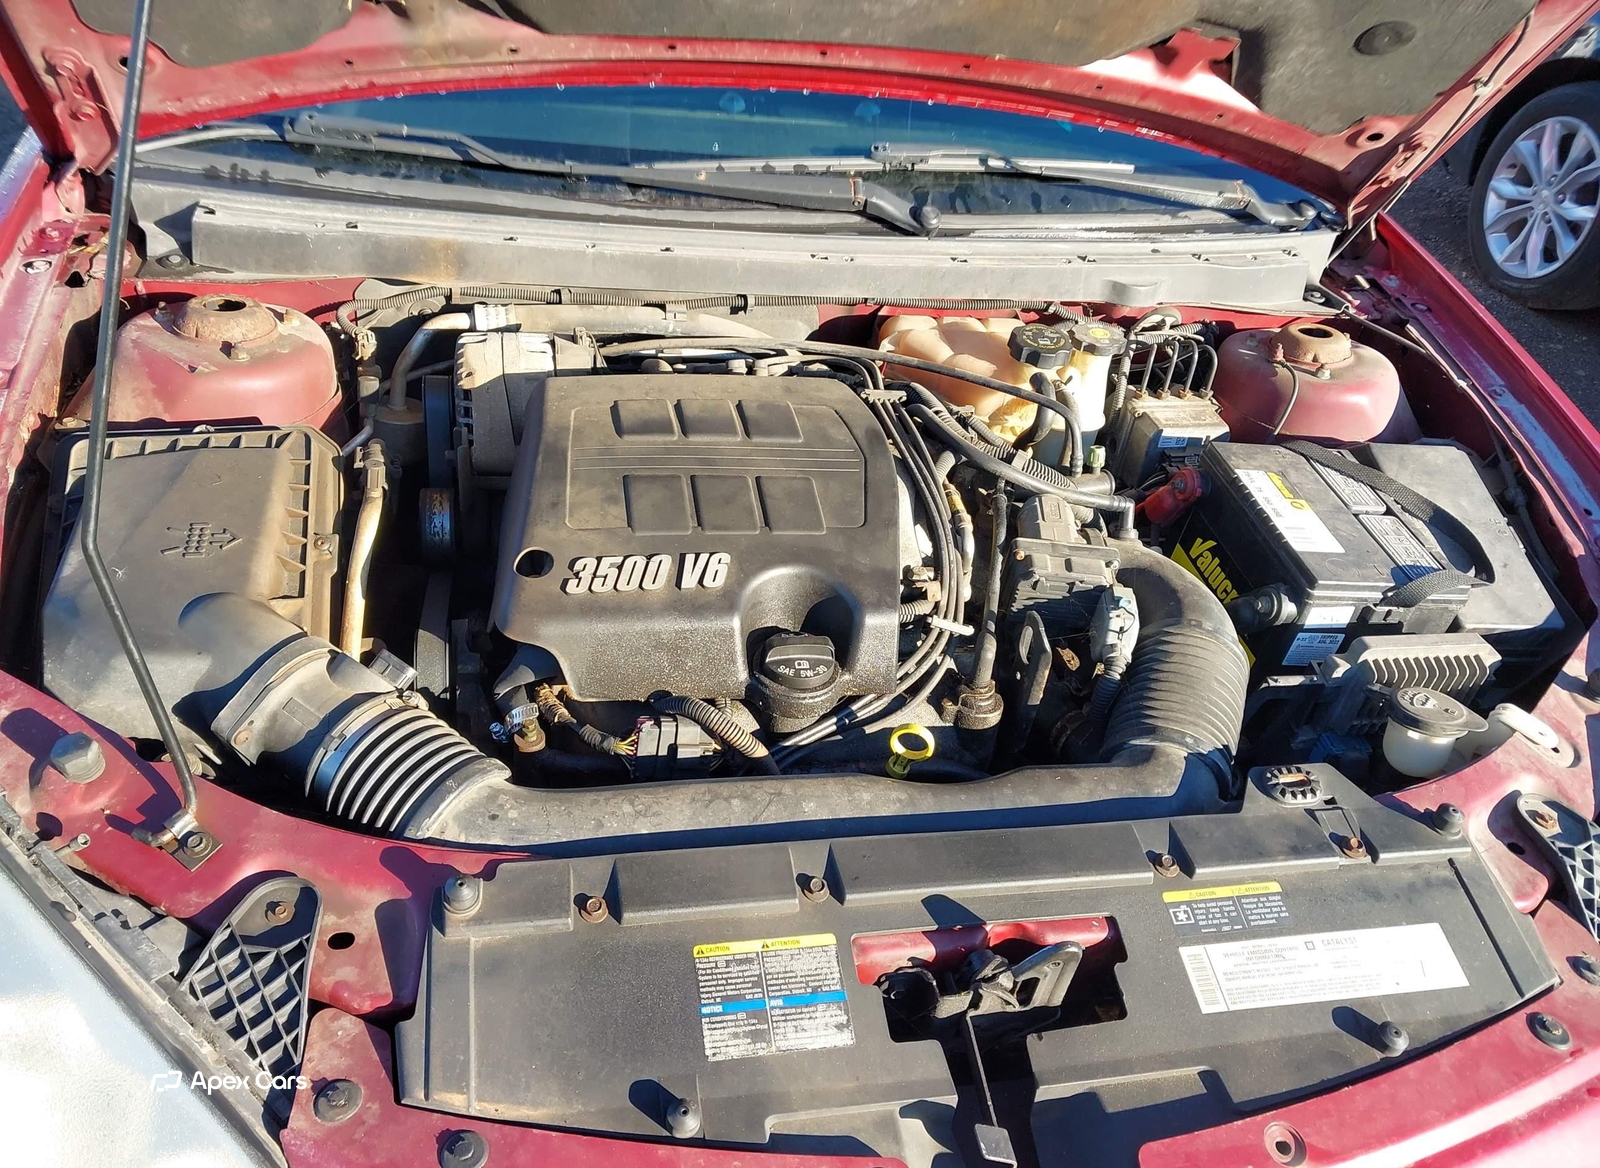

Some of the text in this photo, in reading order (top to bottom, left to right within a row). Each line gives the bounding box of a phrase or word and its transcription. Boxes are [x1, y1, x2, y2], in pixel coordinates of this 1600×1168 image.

[564, 552, 731, 595] 3500 V6
[778, 665, 828, 678] SAE 5W-30
[1322, 937, 1357, 947] CATALYST
[770, 999, 783, 1007] AVIS
[701, 1005, 723, 1014] NOTICE
